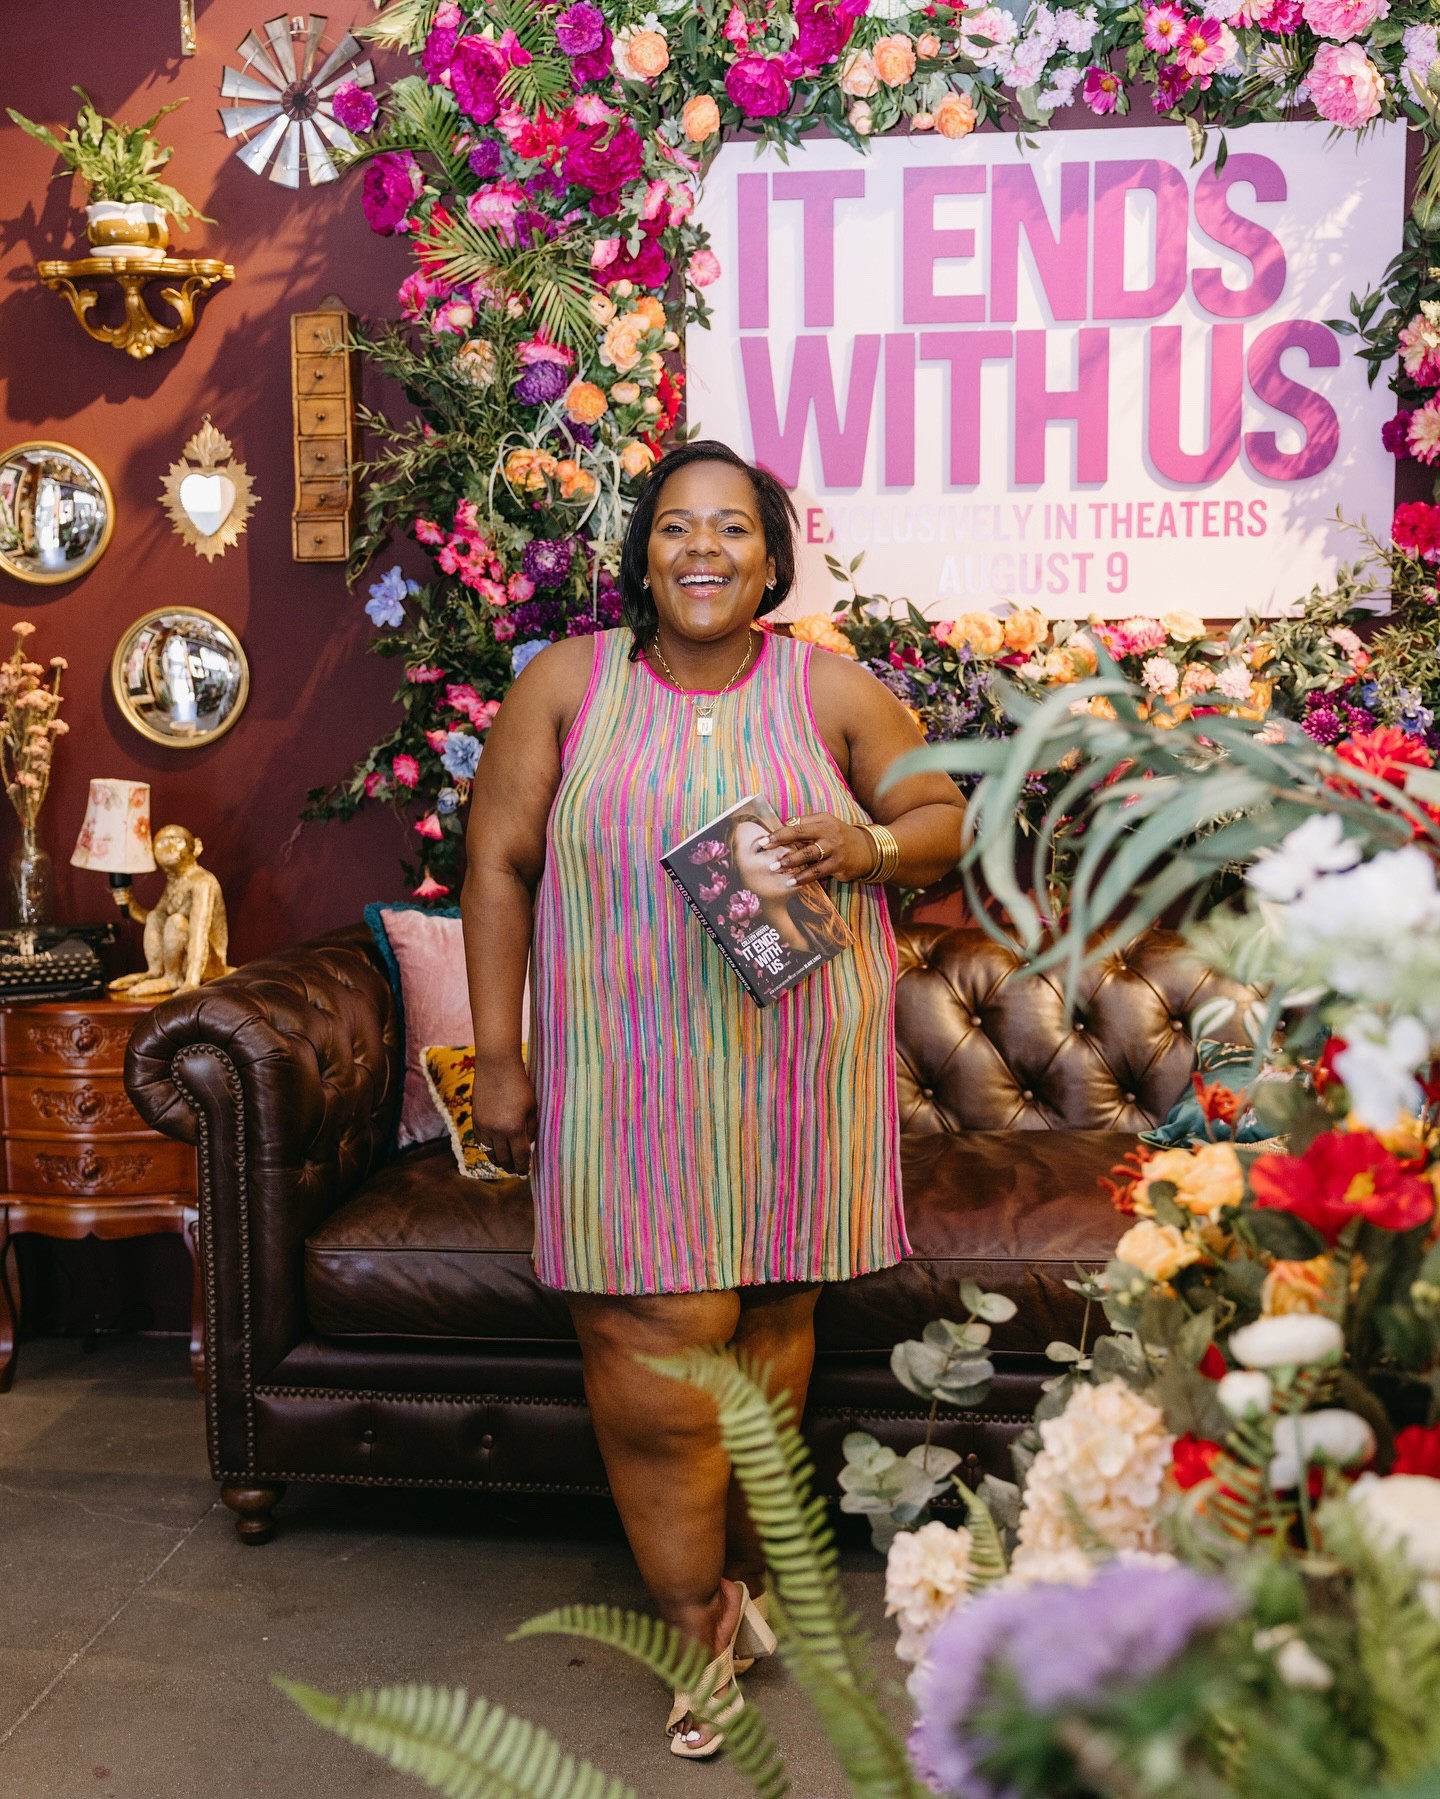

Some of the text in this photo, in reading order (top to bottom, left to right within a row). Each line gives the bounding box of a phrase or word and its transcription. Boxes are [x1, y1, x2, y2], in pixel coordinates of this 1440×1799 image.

[737, 152, 1288, 328] IT ENDS
[740, 319, 1341, 488] WITH US
[806, 499, 1268, 544] EXCLUSIVELY IN THEATERS
[938, 551, 1129, 596] AUGUST 9
[674, 879, 693, 902] ENDS
[690, 903, 708, 926] WITH
[741, 946, 755, 962] IT
[751, 928, 780, 954] ENDS
[754, 942, 783, 968] WITH
[766, 958, 785, 975] US
